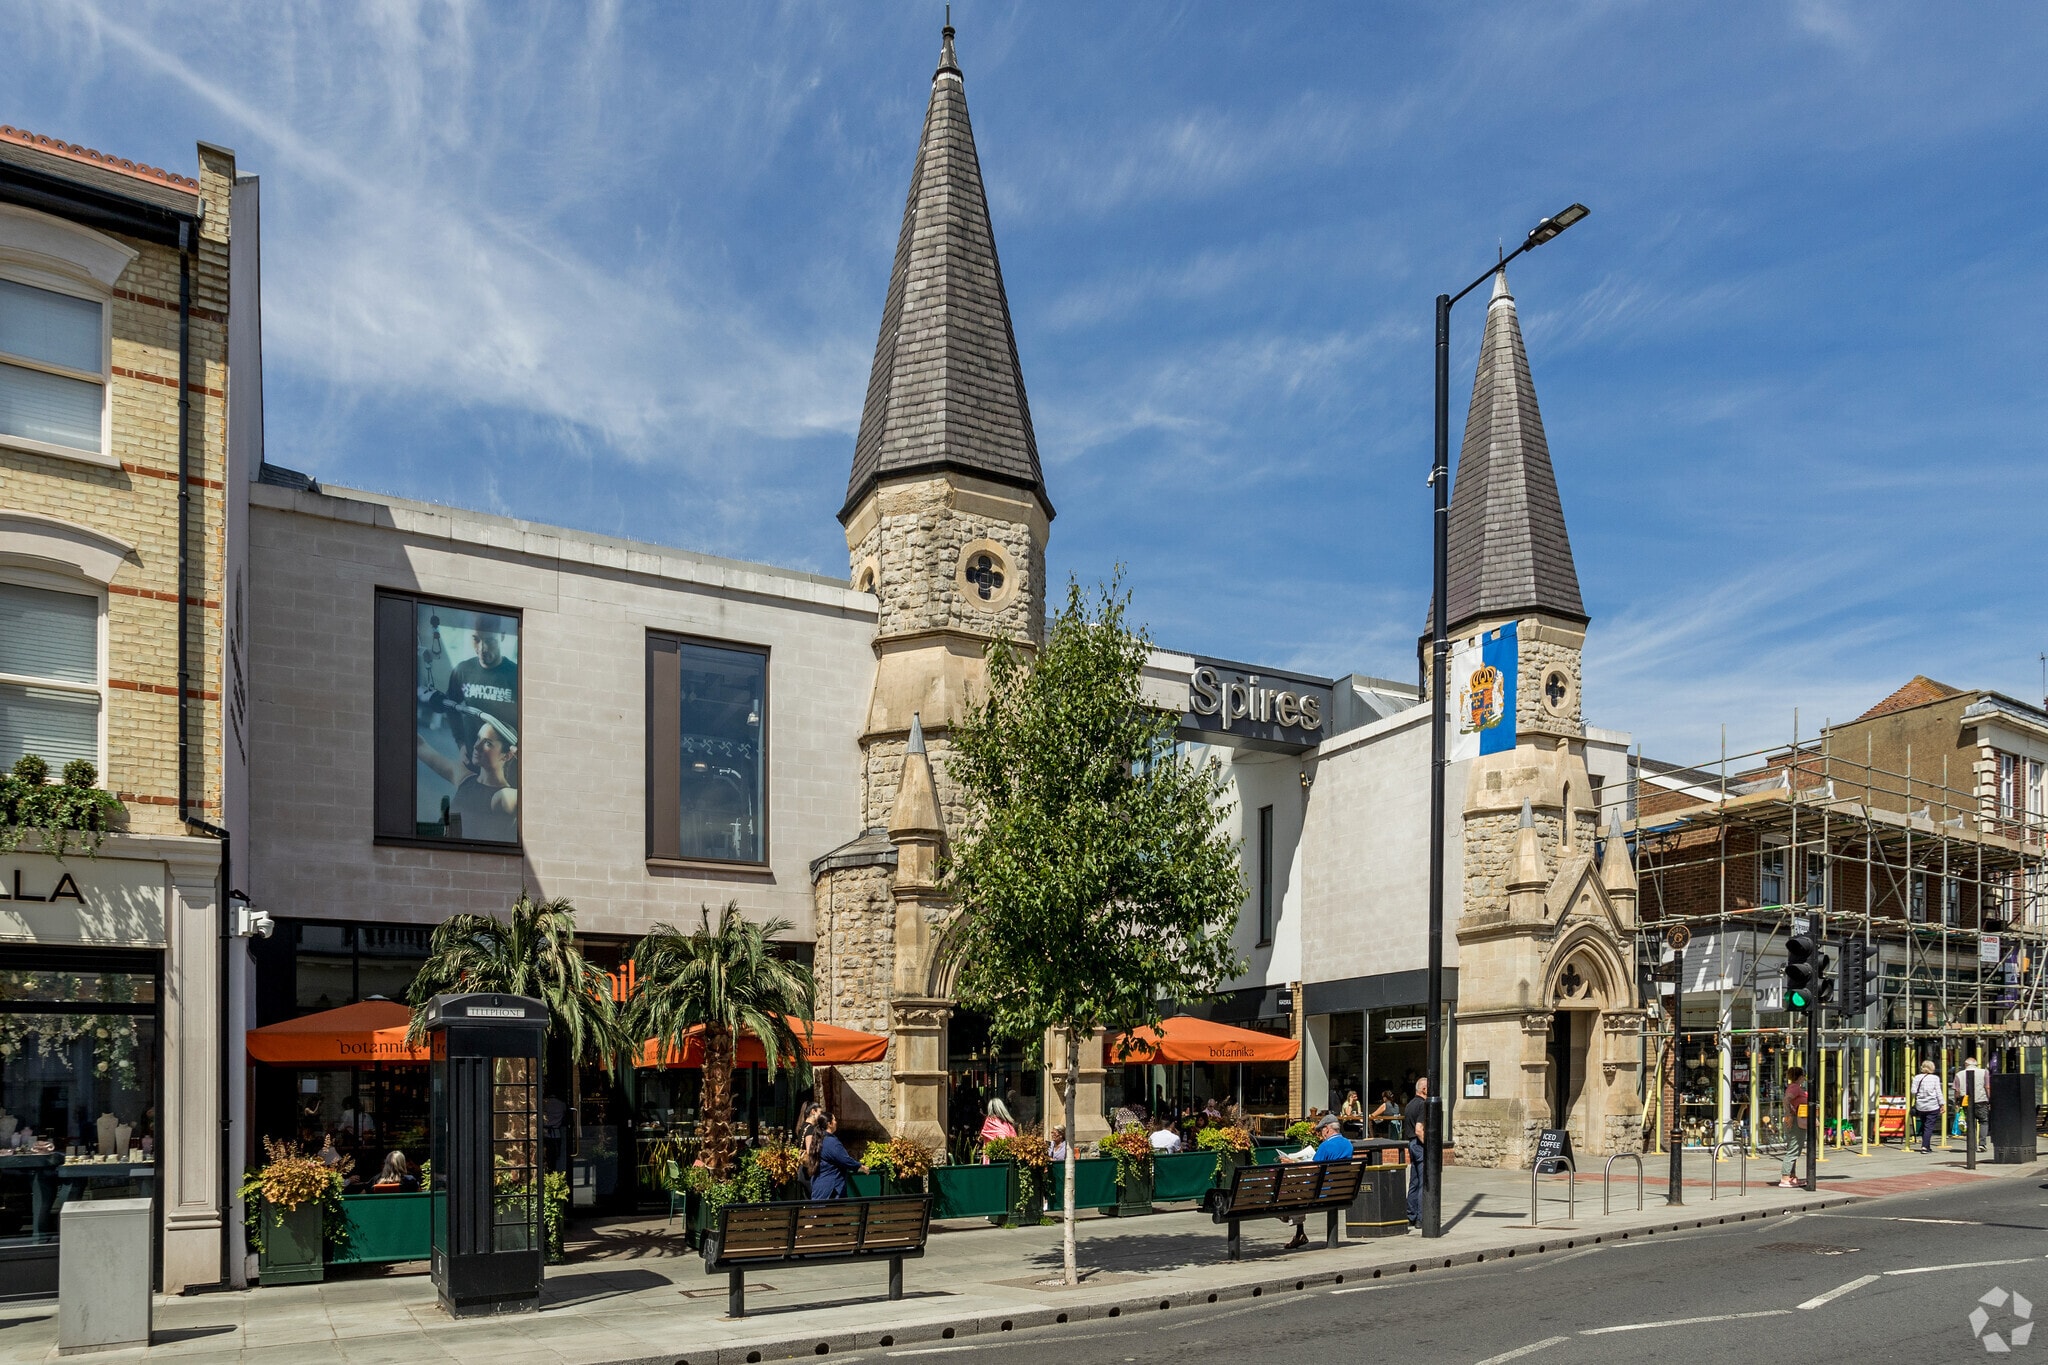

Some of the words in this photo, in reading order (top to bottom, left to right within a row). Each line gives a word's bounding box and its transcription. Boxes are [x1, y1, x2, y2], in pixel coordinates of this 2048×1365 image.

[470, 684, 512, 697] ANYTIME
[1191, 666, 1322, 730] Spires
[1756, 987, 1780, 1002] DIY
[471, 1008, 521, 1017] TELEPHONE
[1388, 1019, 1423, 1031] COFFEE
[1208, 1046, 1255, 1058] botannika
[1542, 1133, 1557, 1141] ICED
[1540, 1140, 1561, 1149] COFFEE
[1537, 1149, 1551, 1157] SOFT
